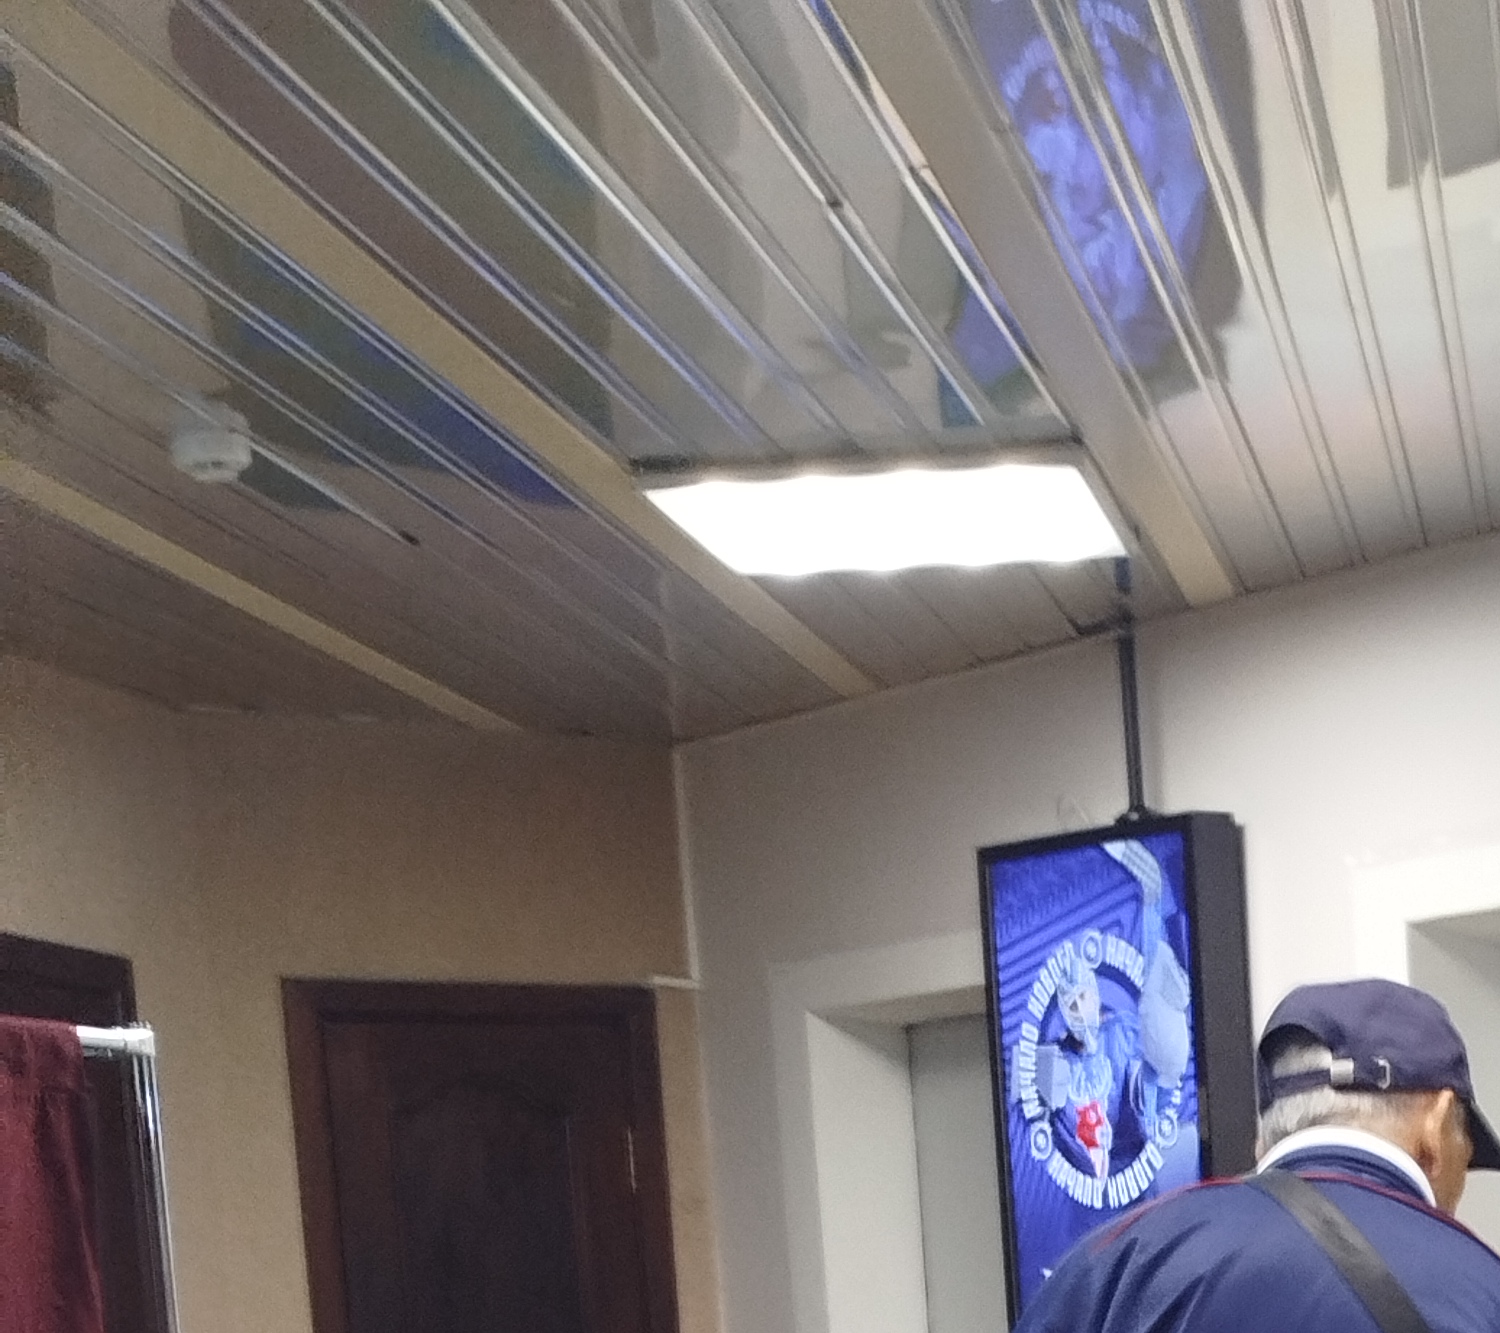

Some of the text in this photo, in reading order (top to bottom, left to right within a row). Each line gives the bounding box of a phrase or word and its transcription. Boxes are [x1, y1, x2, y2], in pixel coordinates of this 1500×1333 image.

[1105, 933, 1145, 988] НАЧА
[1047, 1139, 1164, 1209] НАЧАЛО НОВОГО
